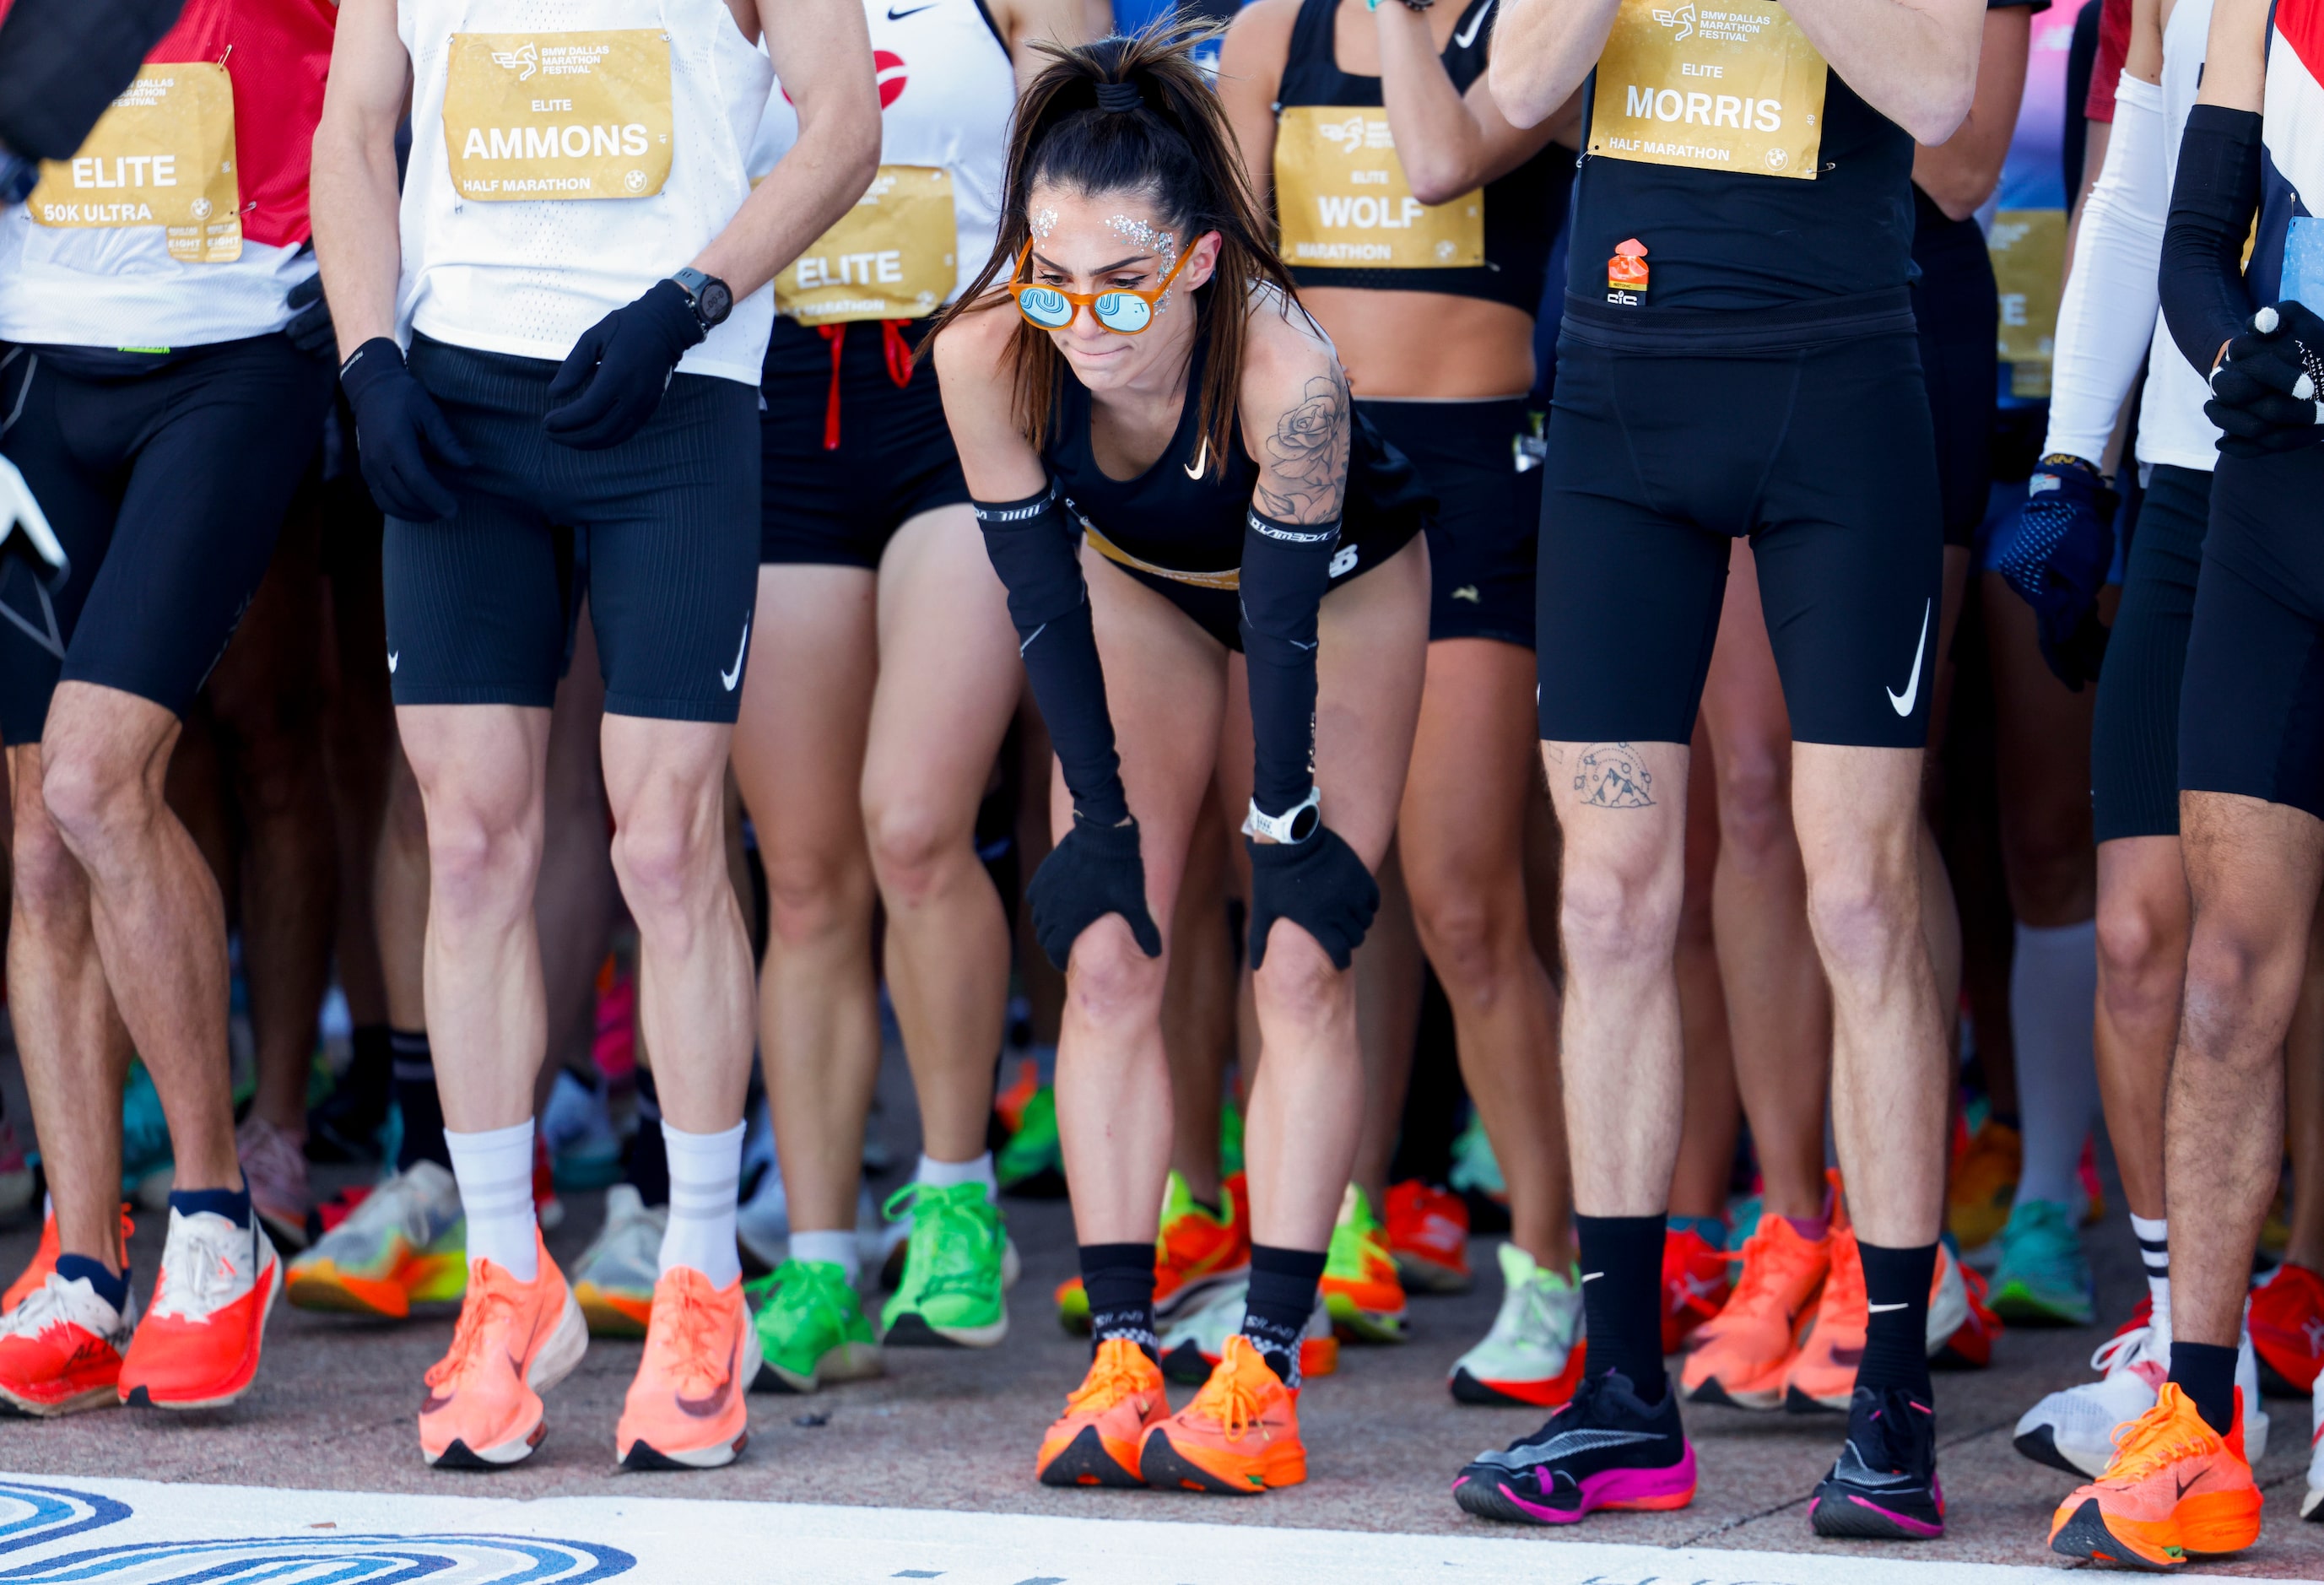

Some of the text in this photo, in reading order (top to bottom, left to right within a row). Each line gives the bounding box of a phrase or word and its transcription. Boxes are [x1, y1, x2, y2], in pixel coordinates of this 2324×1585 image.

[1701, 11, 1770, 25] BMW DALLAS
[1700, 20, 1760, 34] MARATHON
[1699, 30, 1748, 42] FESTIVAL
[542, 46, 609, 56] BMW DALLAS
[542, 55, 601, 65] MARATHON
[543, 65, 591, 75] FESTIVAL
[1682, 63, 1723, 78] ELITE
[120, 87, 166, 98] ARATHON
[532, 99, 572, 112] ELITE
[1625, 84, 1782, 133] MORRIS
[1807, 114, 1816, 126] 49
[462, 124, 649, 160] AMMONS
[1609, 137, 1730, 162] HALF MARATHON
[72, 154, 177, 189] ELITE
[1350, 170, 1390, 185] ELITE
[463, 177, 591, 192] HALF MARATHON
[44, 203, 153, 222] 50K ULTRA
[1317, 195, 1424, 229] WOLF
[1295, 241, 1392, 261] MARATHON
[797, 250, 904, 289] ELITE
